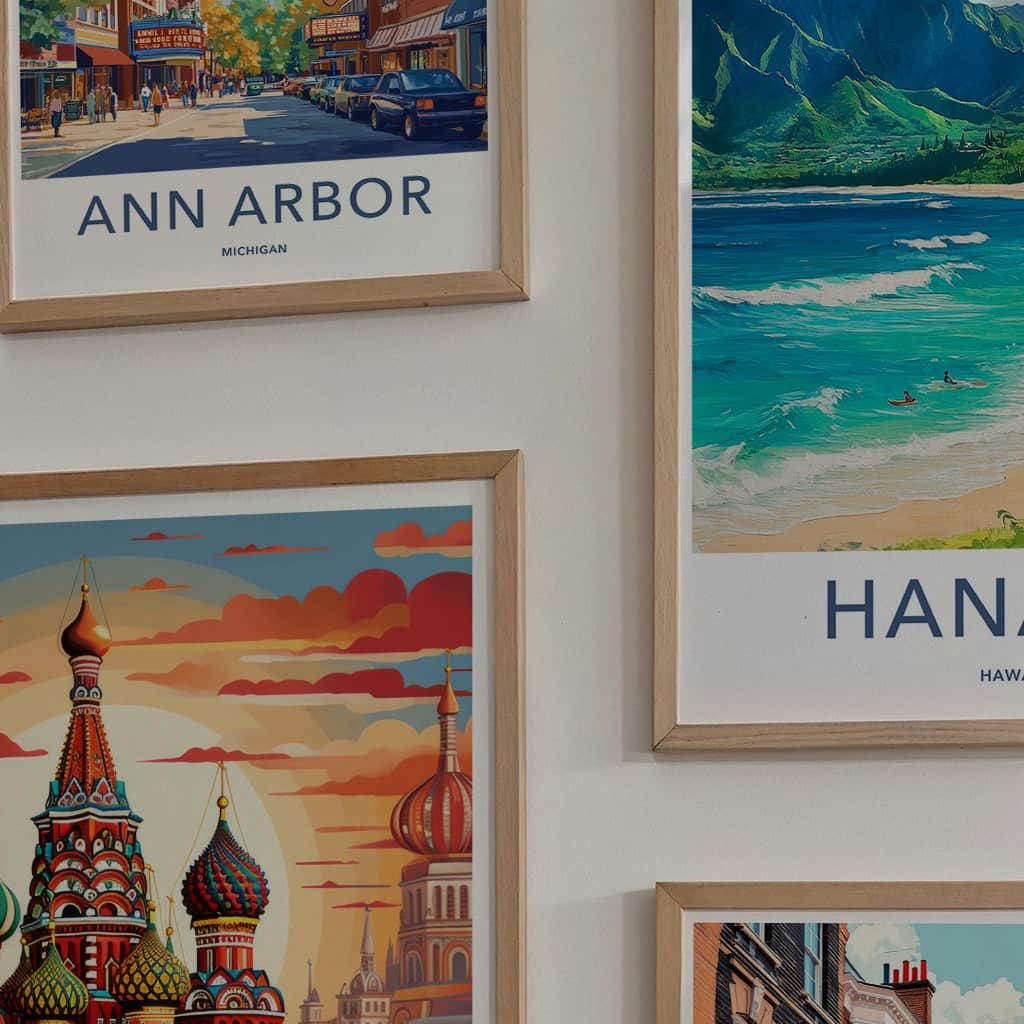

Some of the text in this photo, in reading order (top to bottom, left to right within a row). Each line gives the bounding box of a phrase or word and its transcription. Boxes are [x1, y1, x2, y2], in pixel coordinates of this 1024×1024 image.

[77, 175, 432, 236] ANN ARBOR
[221, 243, 288, 257] MICHIGAN
[826, 577, 1024, 639] HAN
